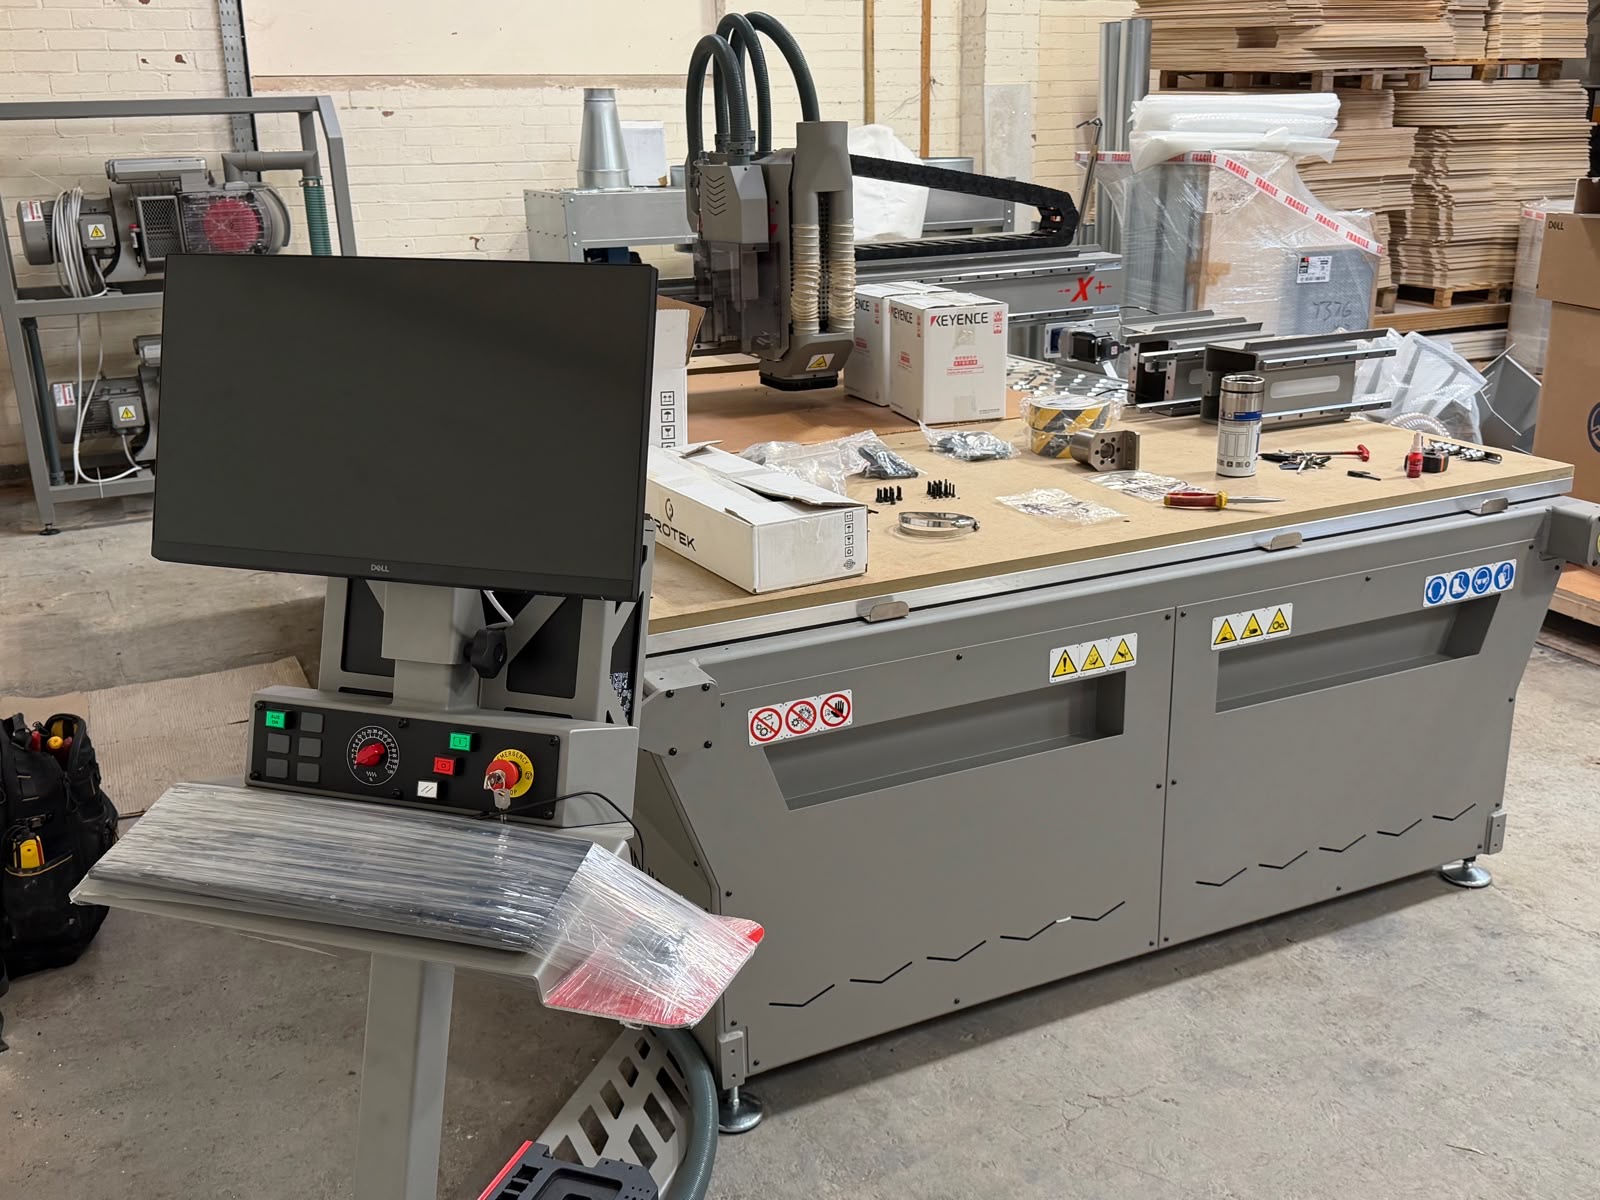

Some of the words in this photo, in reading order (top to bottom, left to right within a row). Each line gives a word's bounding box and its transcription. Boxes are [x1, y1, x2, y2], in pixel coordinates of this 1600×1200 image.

[1191, 153, 1217, 164] FRAGILE
[1225, 159, 1249, 179] FRAGILE
[1254, 177, 1278, 198] FRAGILE
[1284, 195, 1309, 216] FRAGILE
[1314, 213, 1340, 233] FRAGILE
[1345, 231, 1370, 249] FRAGILE
[1548, 221, 1564, 230] DELL
[855, 298, 870, 312] ENCE
[930, 312, 989, 327] KEYENCE
[650, 516, 697, 552] ROTEK
[370, 564, 390, 573] DELL
